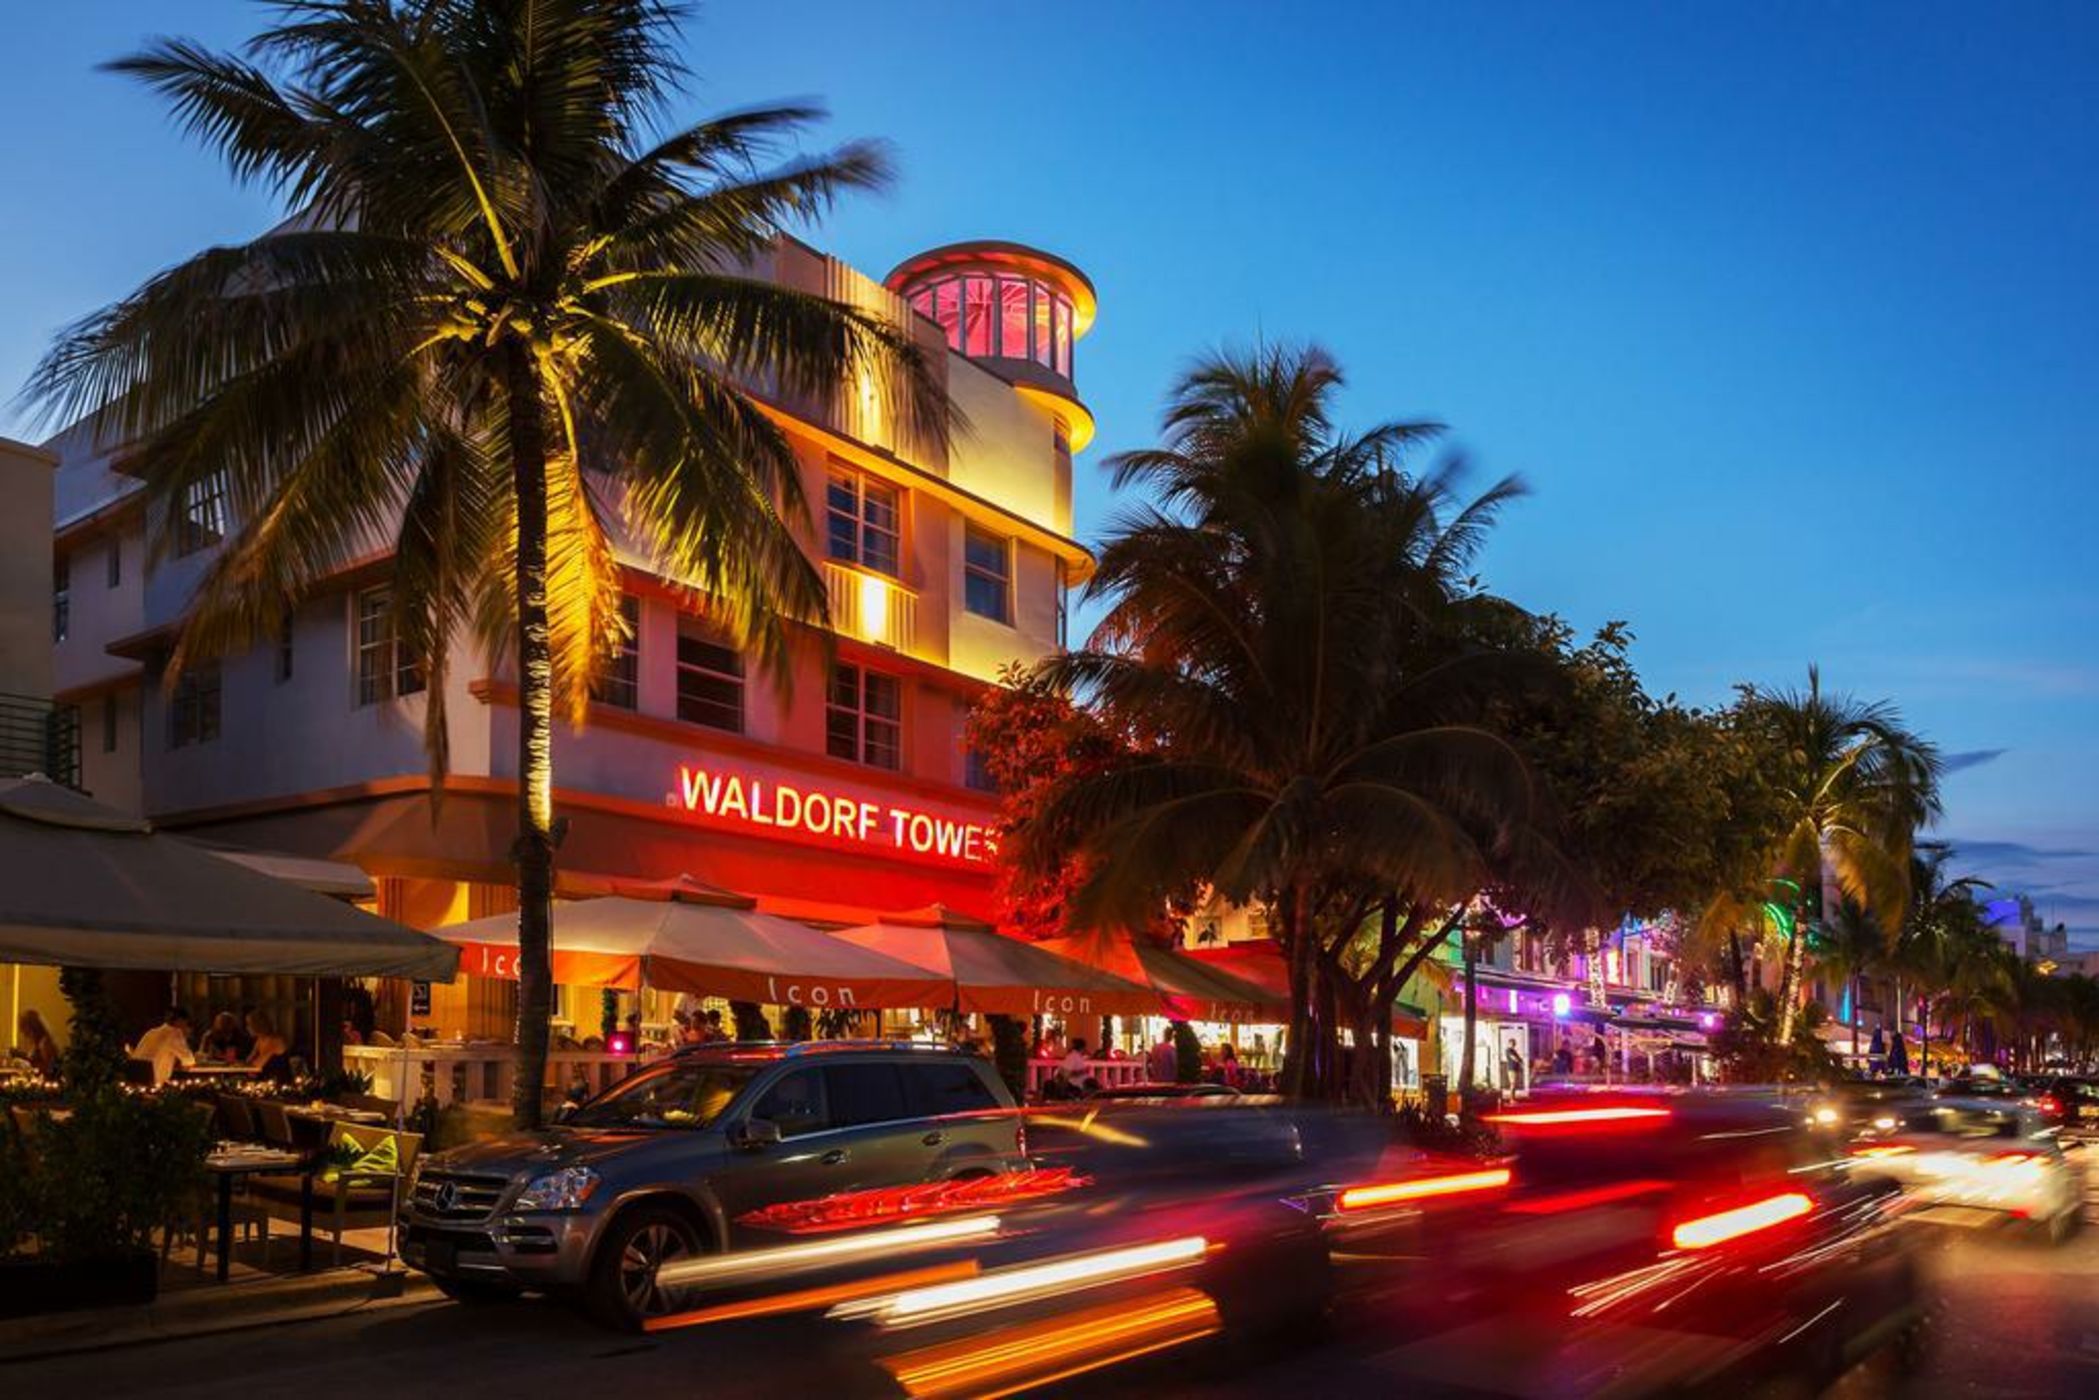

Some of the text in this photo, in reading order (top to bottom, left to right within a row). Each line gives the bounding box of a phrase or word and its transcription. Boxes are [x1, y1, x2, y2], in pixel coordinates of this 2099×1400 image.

[681, 766, 880, 840] WALDORF
[768, 976, 856, 1006] Icon
[1034, 988, 1090, 1014] Icon
